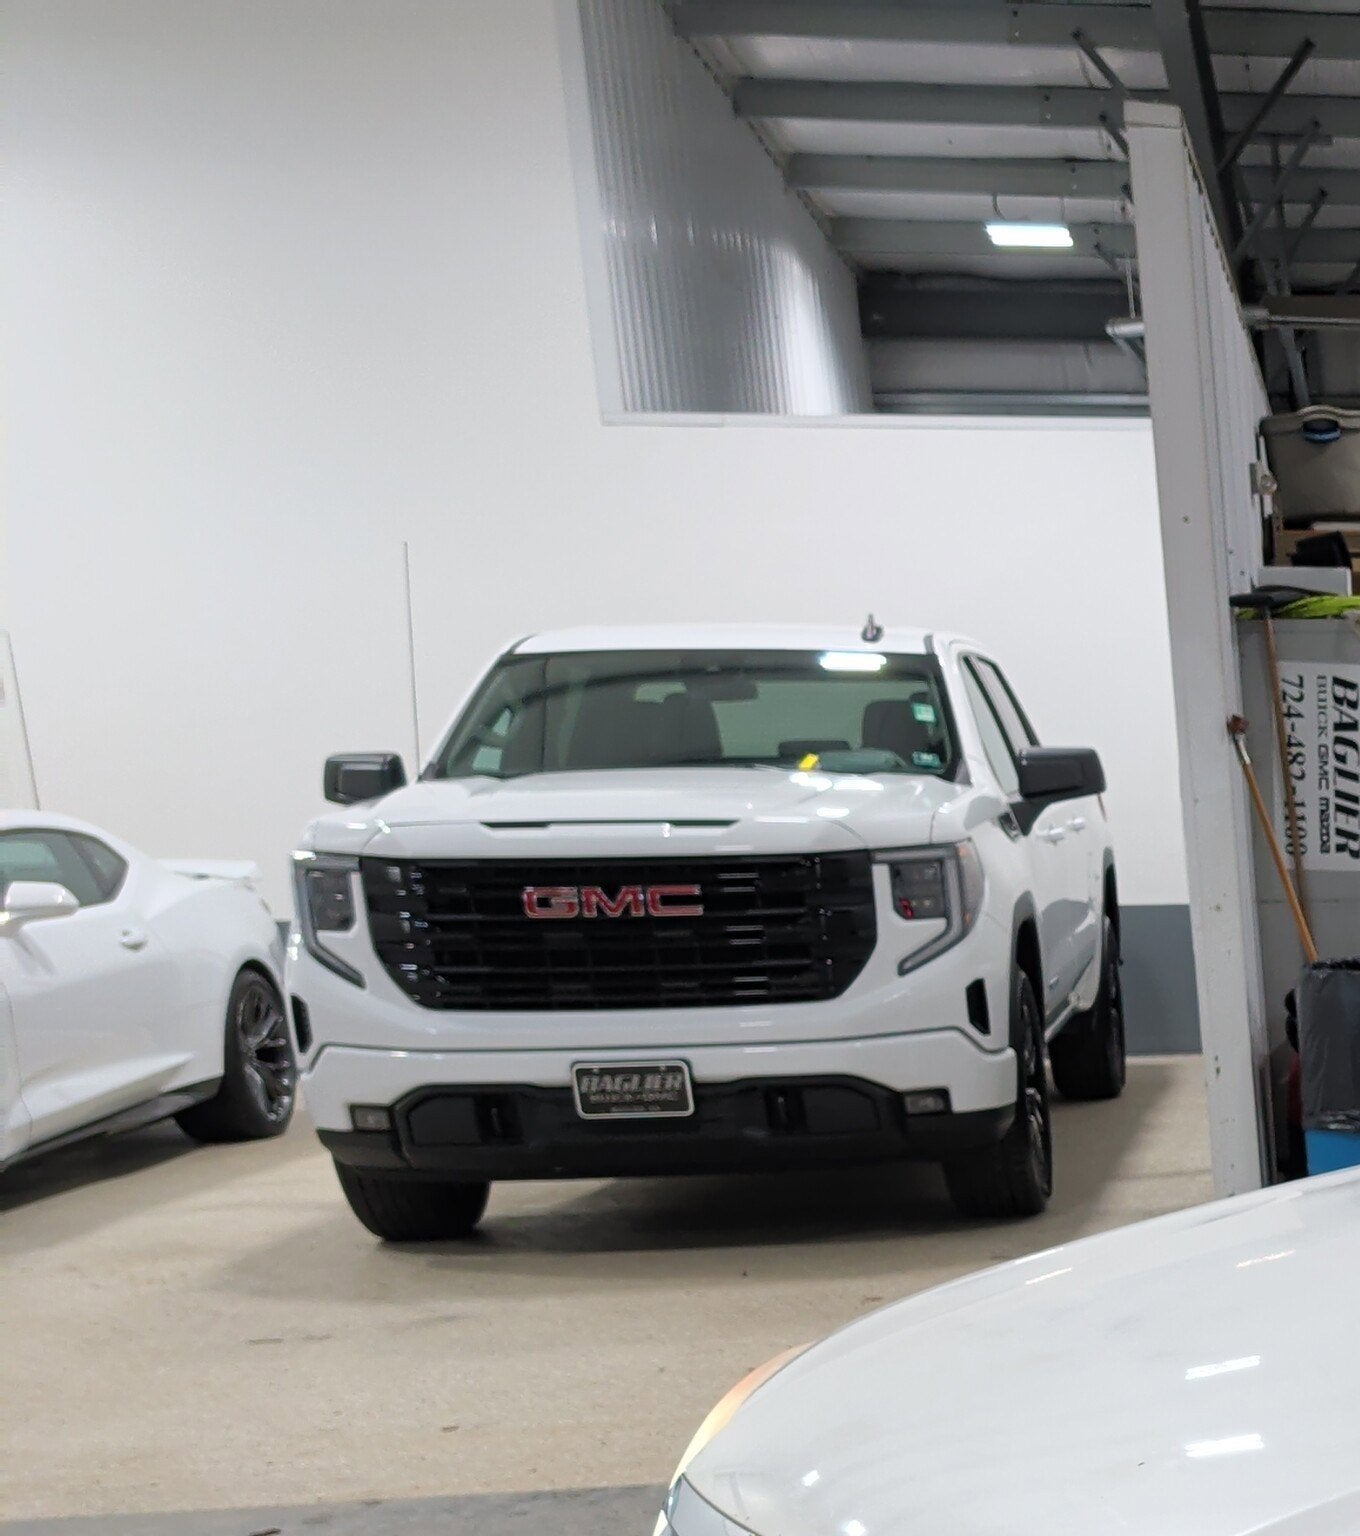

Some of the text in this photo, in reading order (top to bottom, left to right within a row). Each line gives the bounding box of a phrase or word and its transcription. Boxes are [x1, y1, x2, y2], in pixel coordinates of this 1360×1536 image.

[1316, 675, 1329, 738] BUICK
[1317, 744, 1330, 791] GMC
[523, 884, 704, 919] GMC
